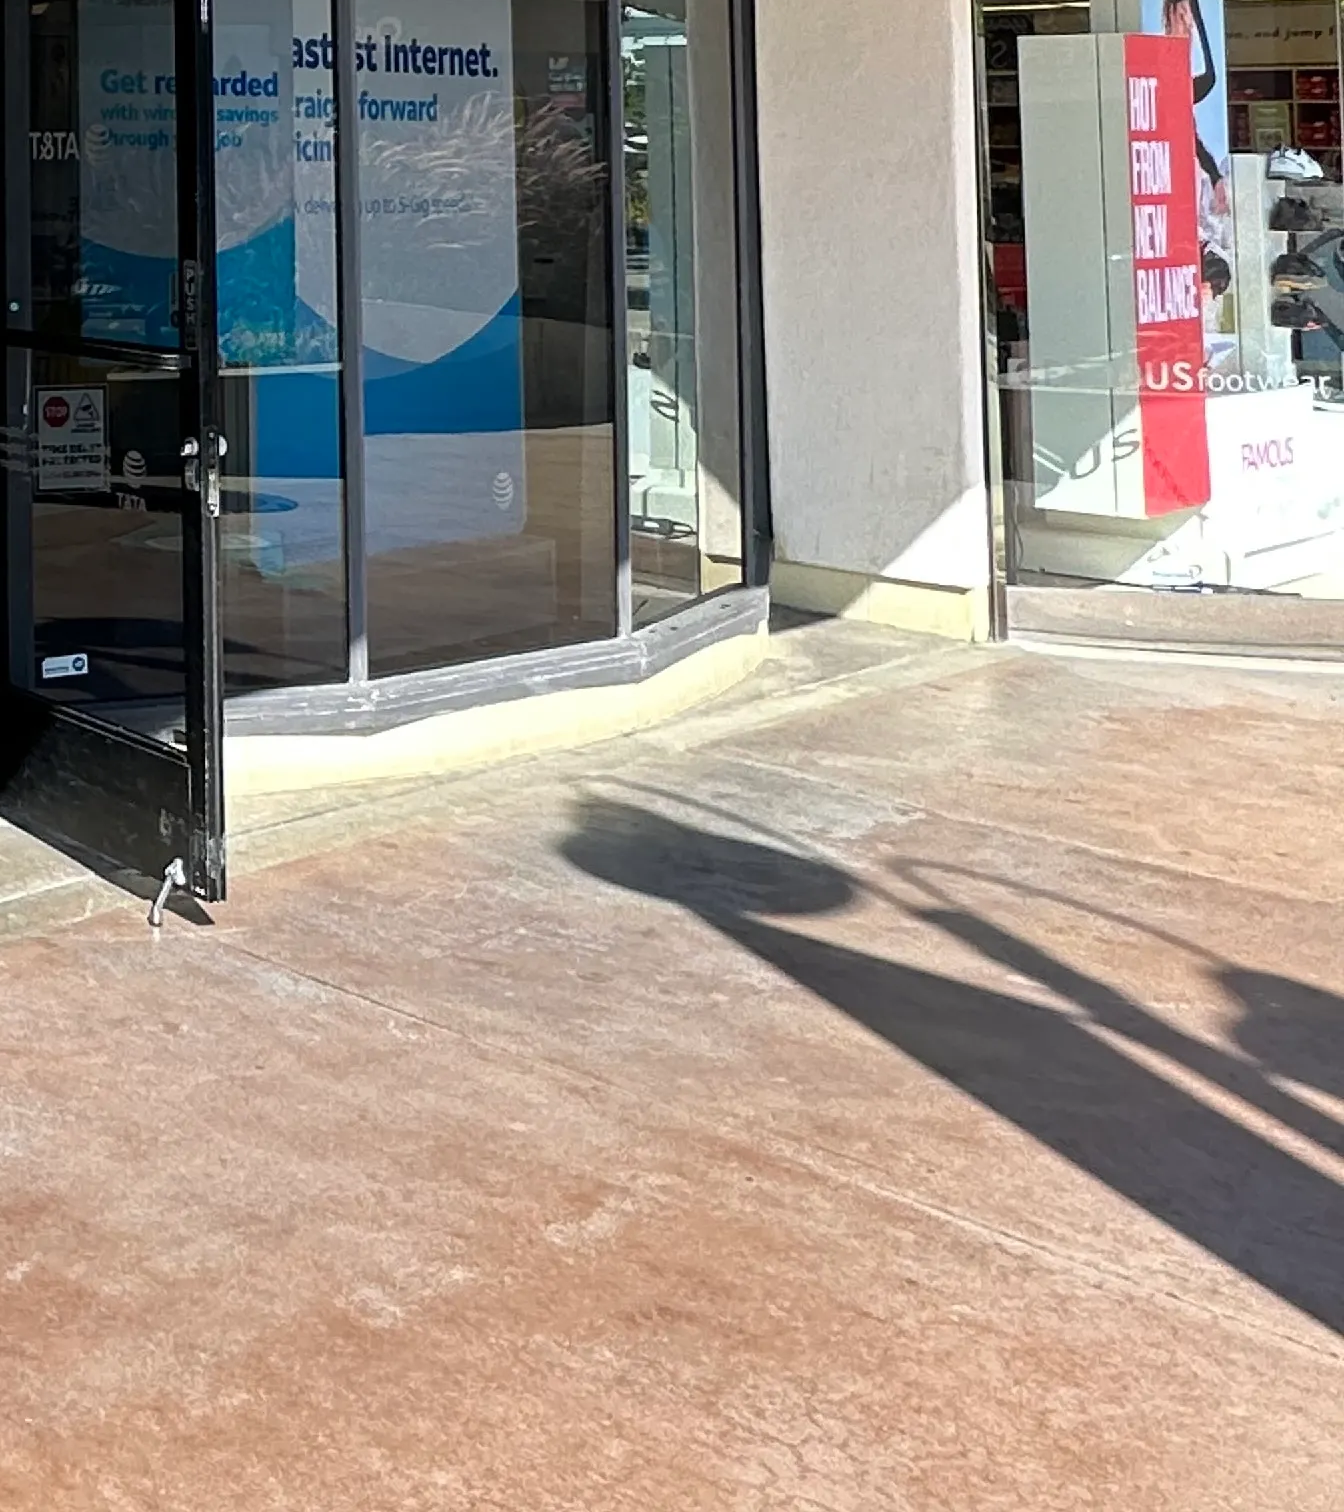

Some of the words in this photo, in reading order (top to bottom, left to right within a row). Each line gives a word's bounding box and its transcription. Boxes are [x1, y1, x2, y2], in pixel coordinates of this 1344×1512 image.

[292, 32, 378, 73] astst
[384, 34, 499, 79] Internet.
[100, 69, 148, 94] Get
[1128, 76, 1158, 132] HOT
[100, 102, 139, 121] with
[216, 105, 280, 127] savings
[1130, 140, 1172, 196] FROM
[1133, 204, 1168, 260] NEW
[1136, 264, 1199, 325] BALANCE
[1145, 360, 1192, 392] US
